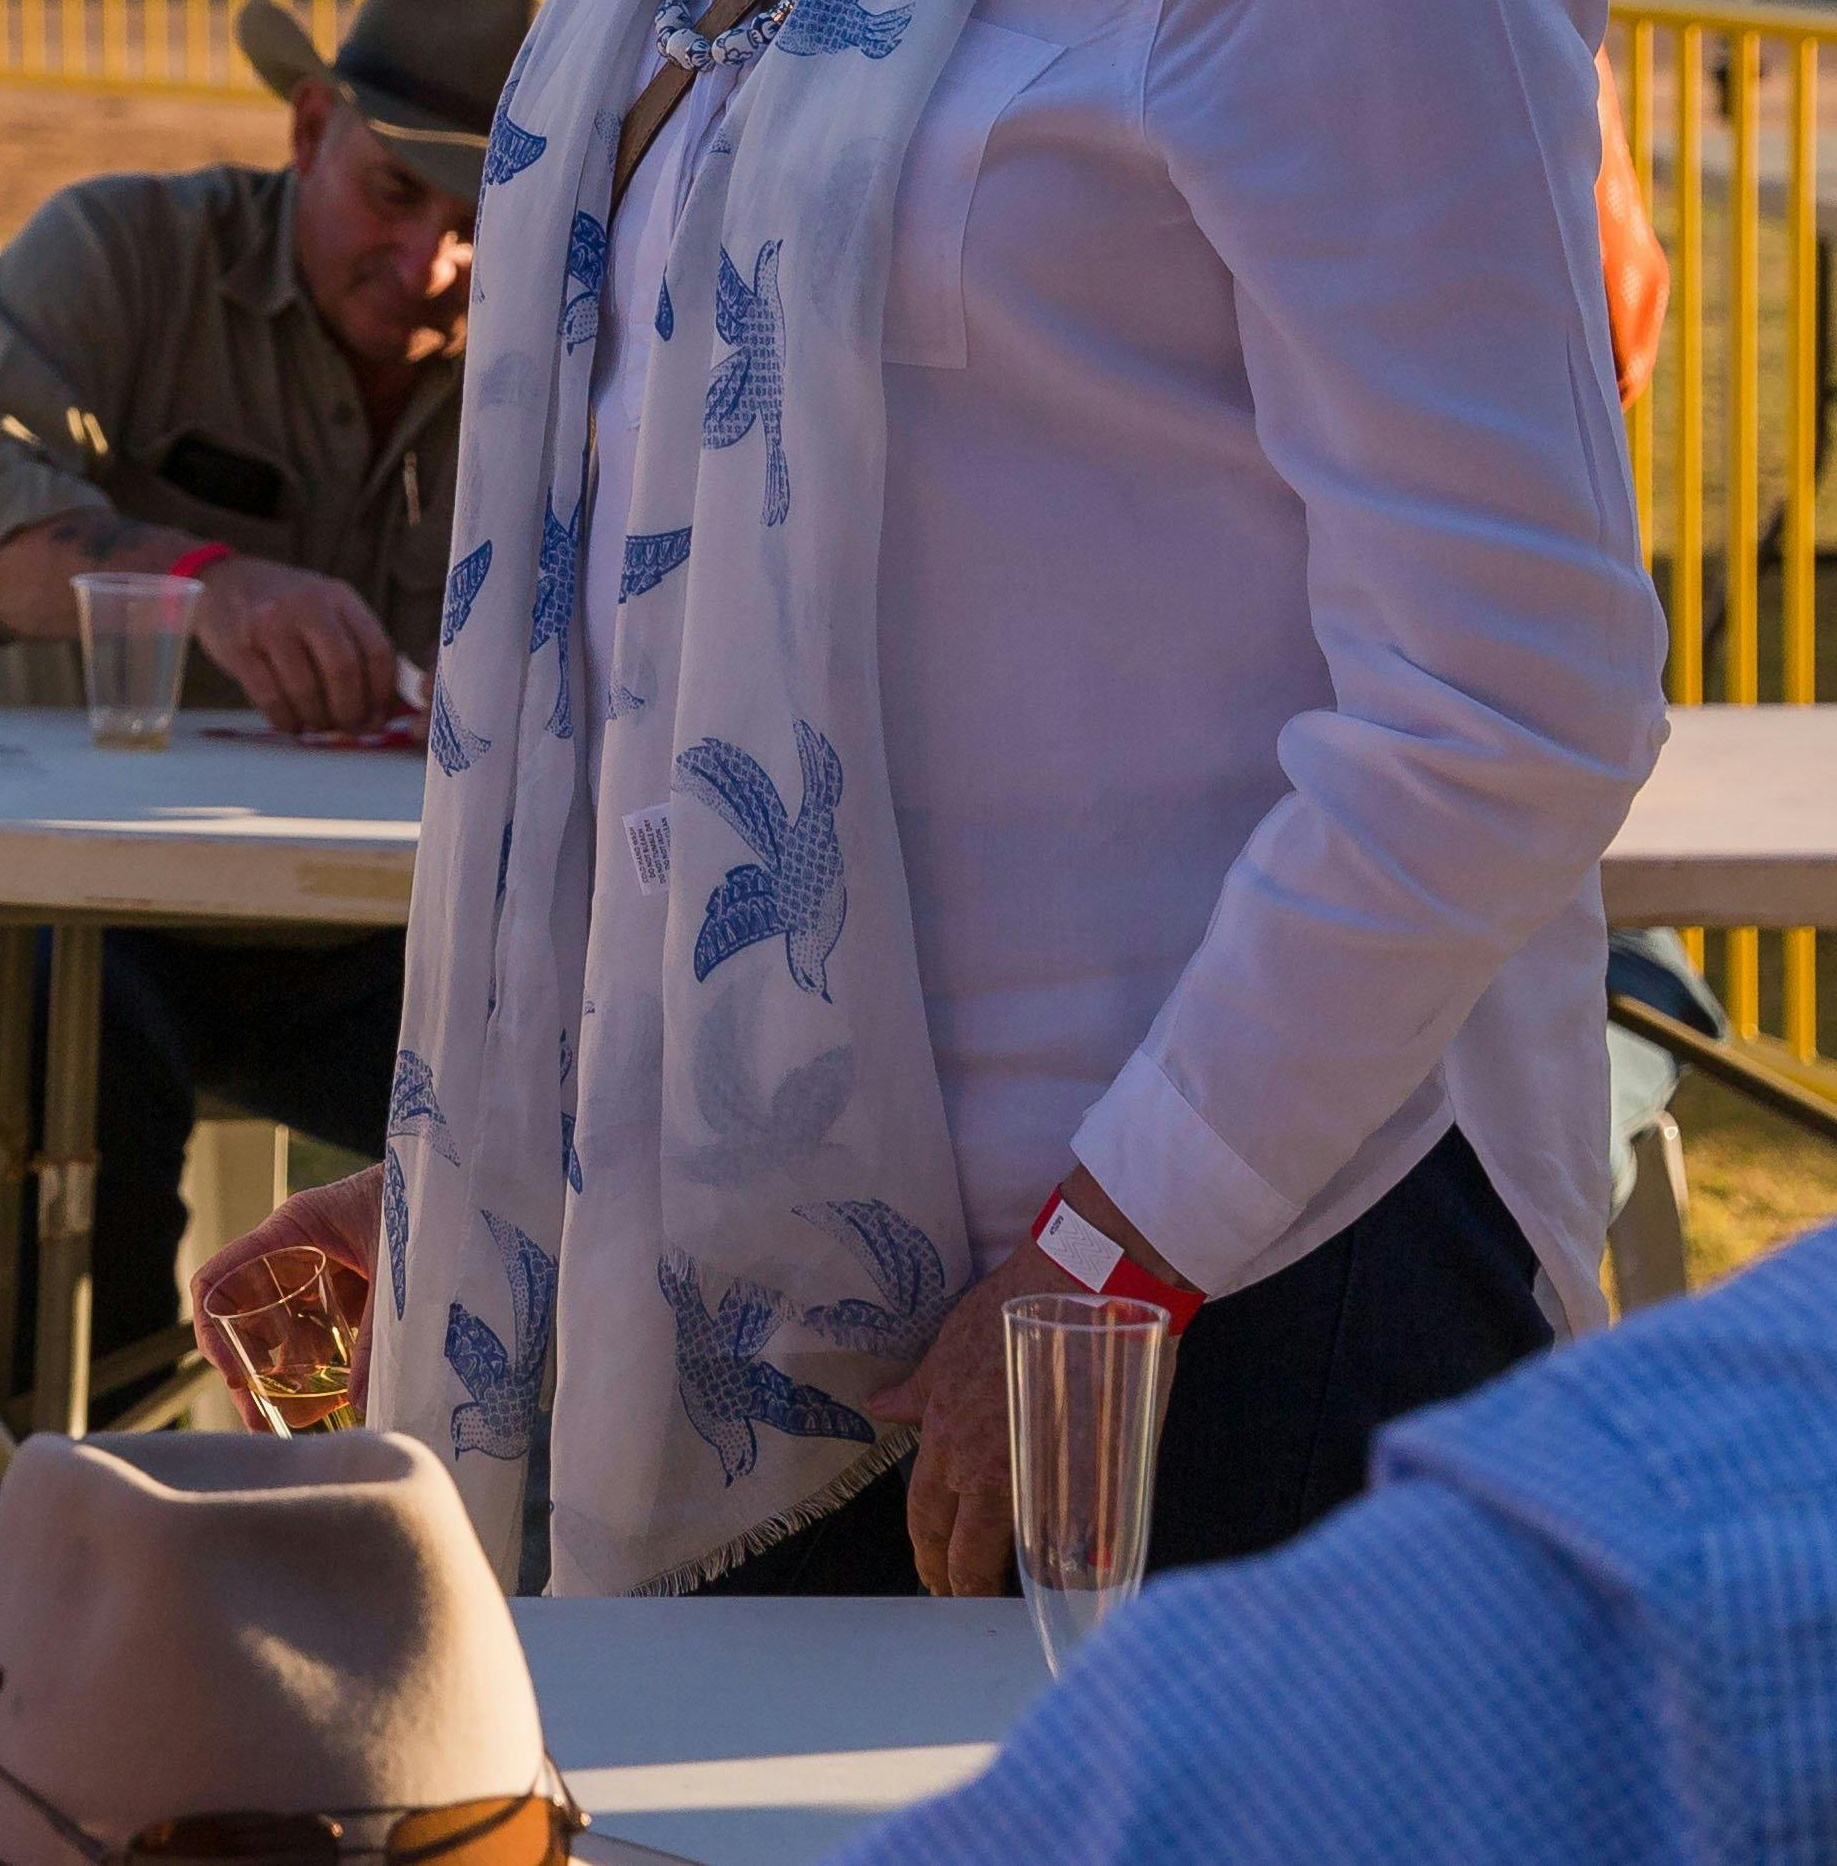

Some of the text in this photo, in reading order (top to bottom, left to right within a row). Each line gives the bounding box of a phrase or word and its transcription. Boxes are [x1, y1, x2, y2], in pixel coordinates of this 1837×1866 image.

[644, 819, 652, 832] DRY
[637, 828, 656, 878] DO NOT BLEACH
[659, 845, 668, 859] NOT
[654, 860, 663, 873] NOT
[663, 860, 671, 870] DO
[658, 874, 666, 884] DO
